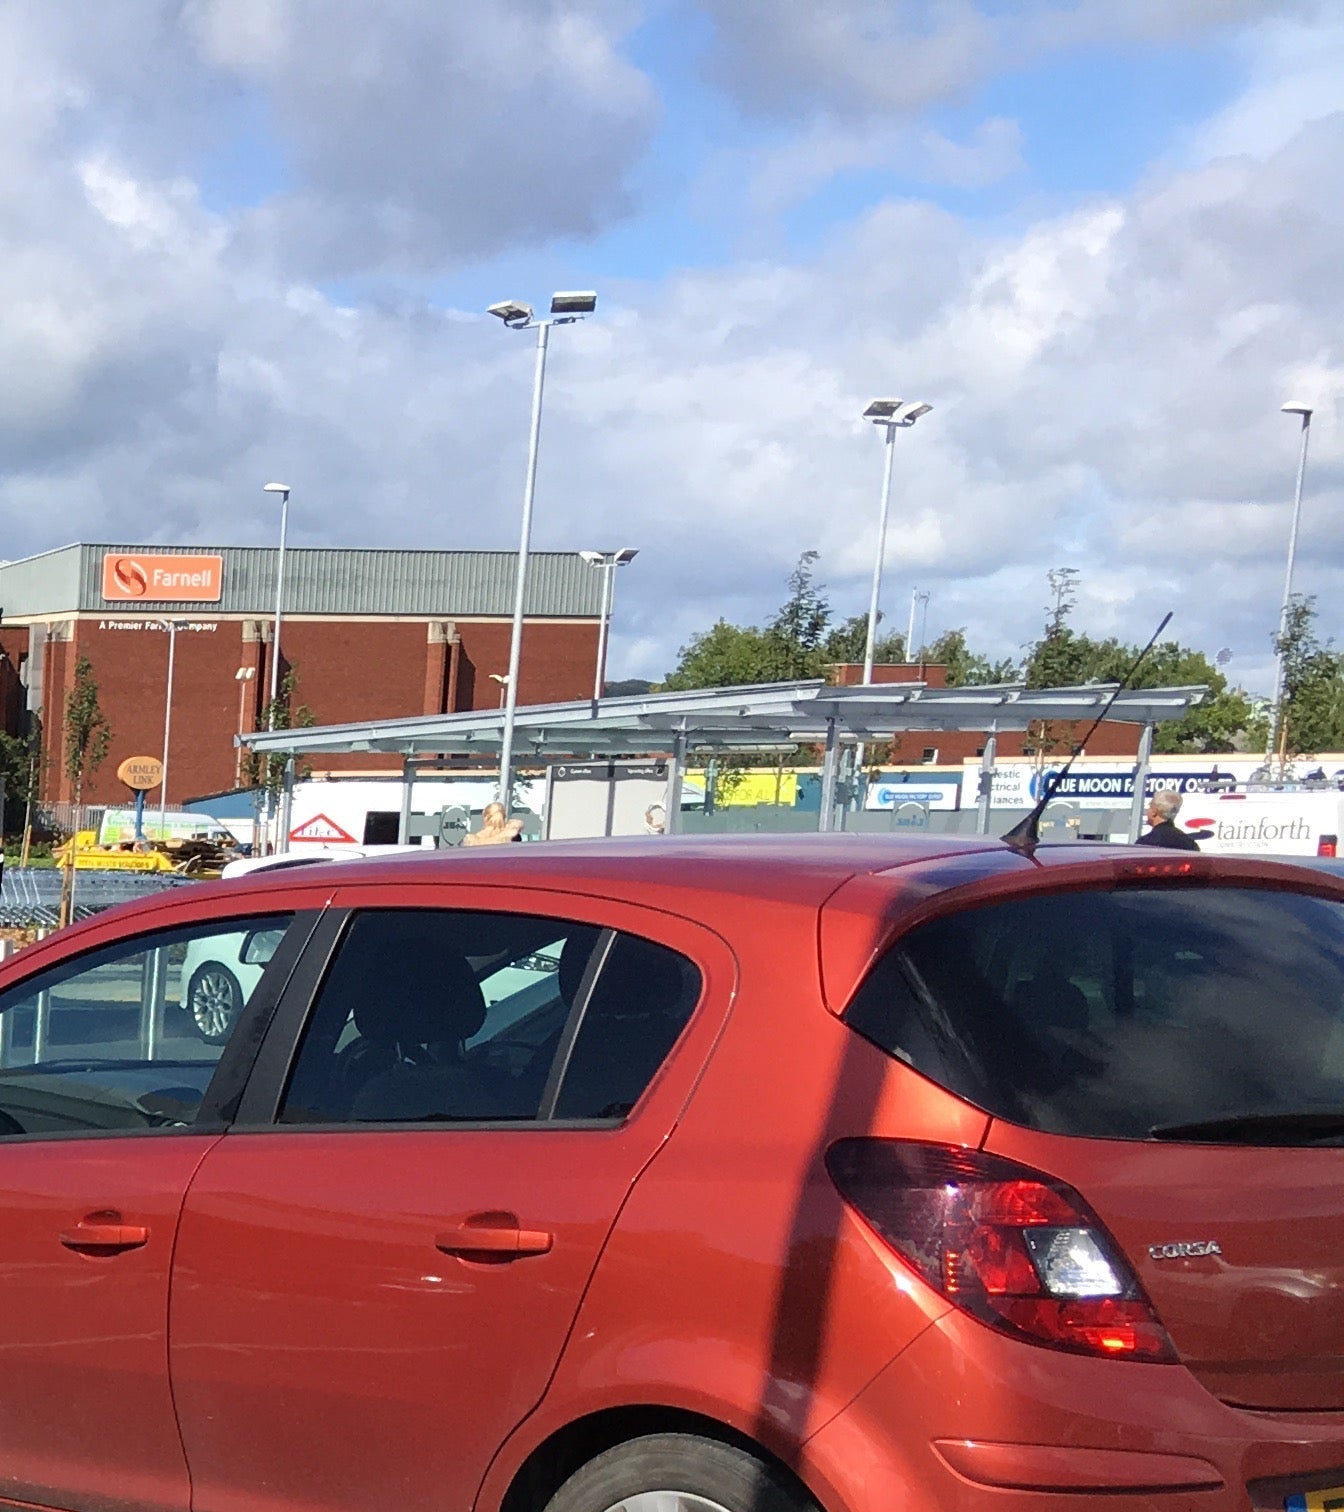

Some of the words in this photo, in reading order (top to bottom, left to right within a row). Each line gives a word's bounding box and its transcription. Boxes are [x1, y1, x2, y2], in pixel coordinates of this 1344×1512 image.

[152, 568, 212, 588] Farnell
[98, 621, 106, 630] A
[109, 621, 143, 631] Premier
[127, 764, 162, 775] ARMLEY
[133, 775, 154, 785] LINK
[1079, 778, 1122, 793] MOON
[1148, 1240, 1222, 1260] CORSA
